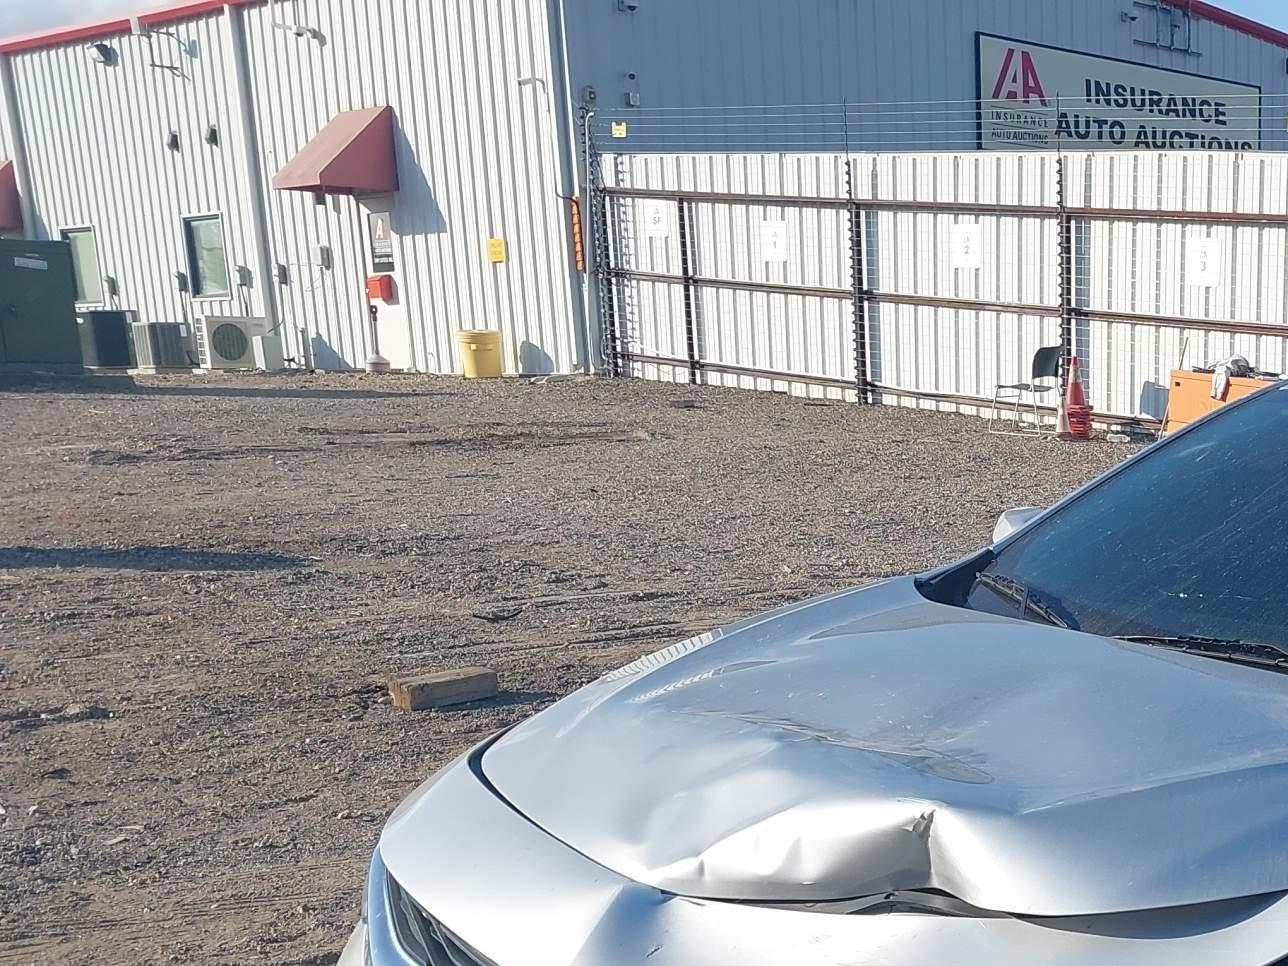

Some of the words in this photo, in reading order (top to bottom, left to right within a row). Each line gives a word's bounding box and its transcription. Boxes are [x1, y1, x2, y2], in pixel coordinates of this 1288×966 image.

[1084, 78, 1227, 126] INSURANCE
[991, 111, 1049, 128] INSURANCE
[1055, 111, 1126, 145] AUTO
[1012, 130, 1049, 144] AUCTIONS
